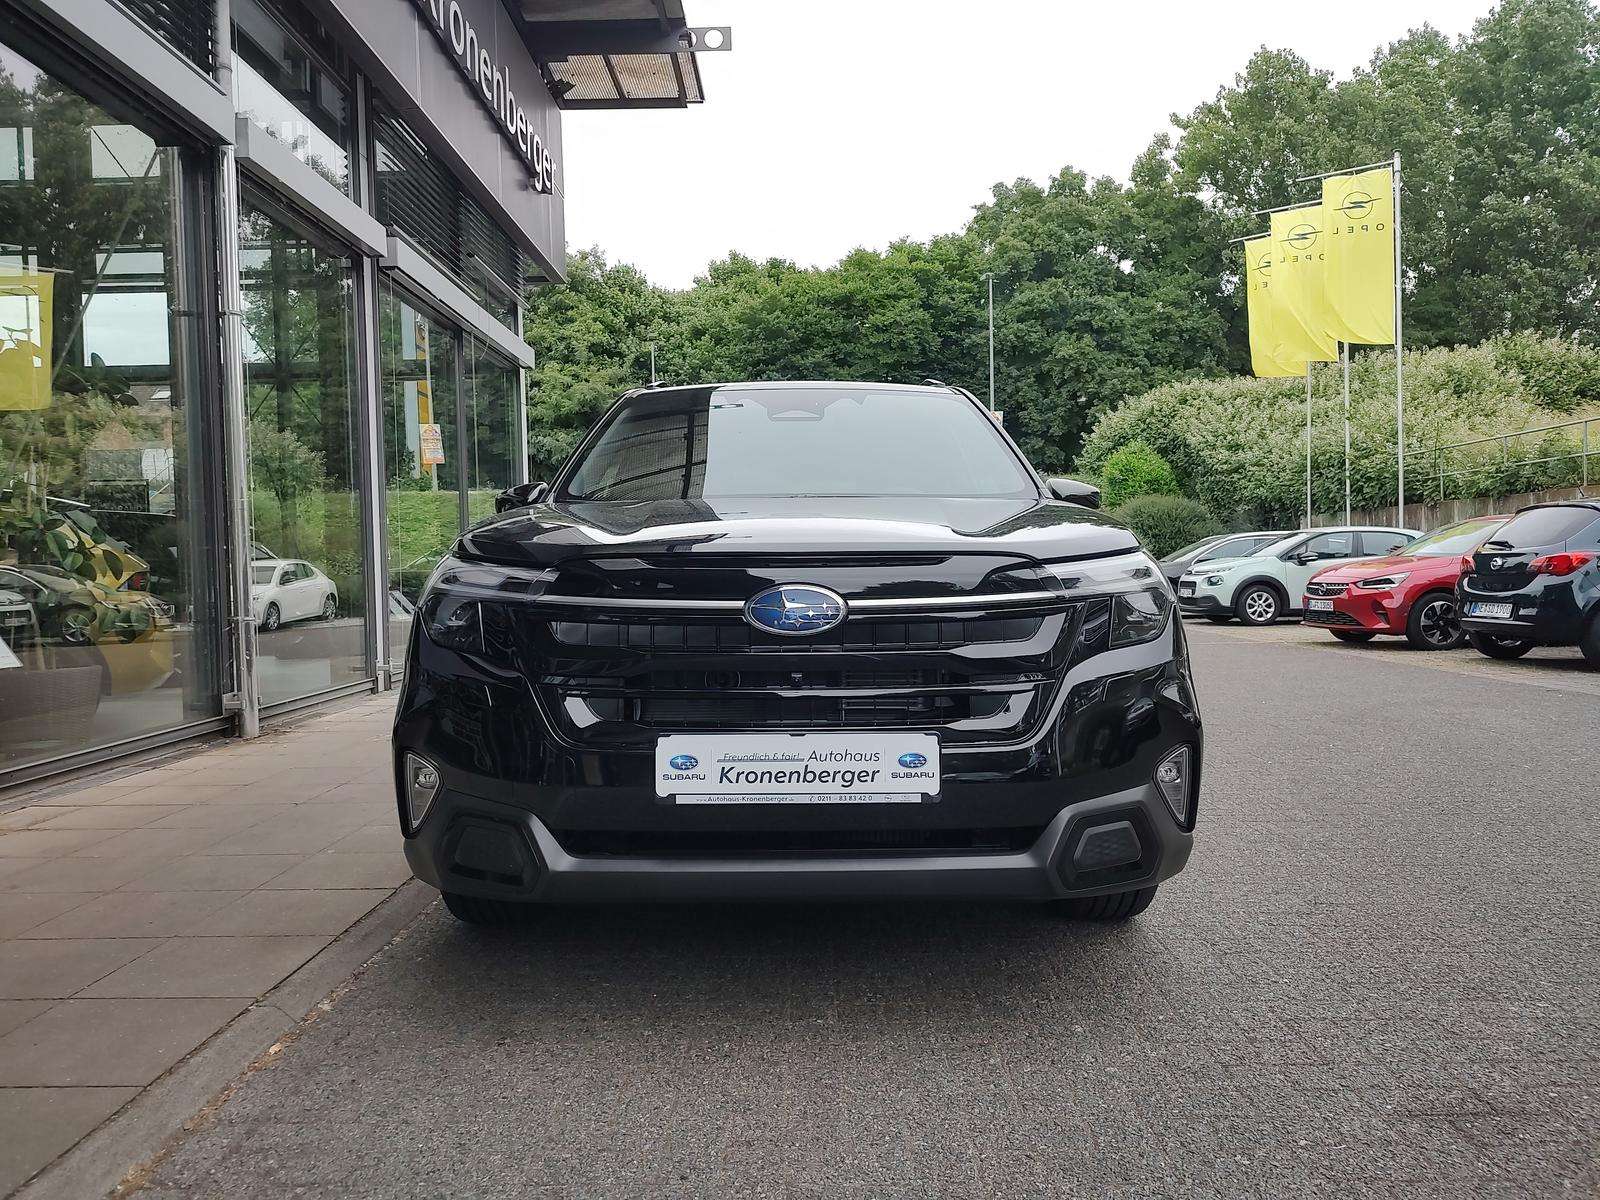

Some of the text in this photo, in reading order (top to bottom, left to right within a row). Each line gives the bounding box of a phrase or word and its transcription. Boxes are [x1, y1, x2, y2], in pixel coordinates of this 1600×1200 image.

[423, 0, 556, 195] onenberger
[723, 752, 800, 762] Freundlich & fair!
[807, 748, 881, 763] Autohaus
[662, 773, 706, 781] SUBARU
[718, 764, 881, 788] Kronenberger
[891, 771, 935, 779] SUBARU
